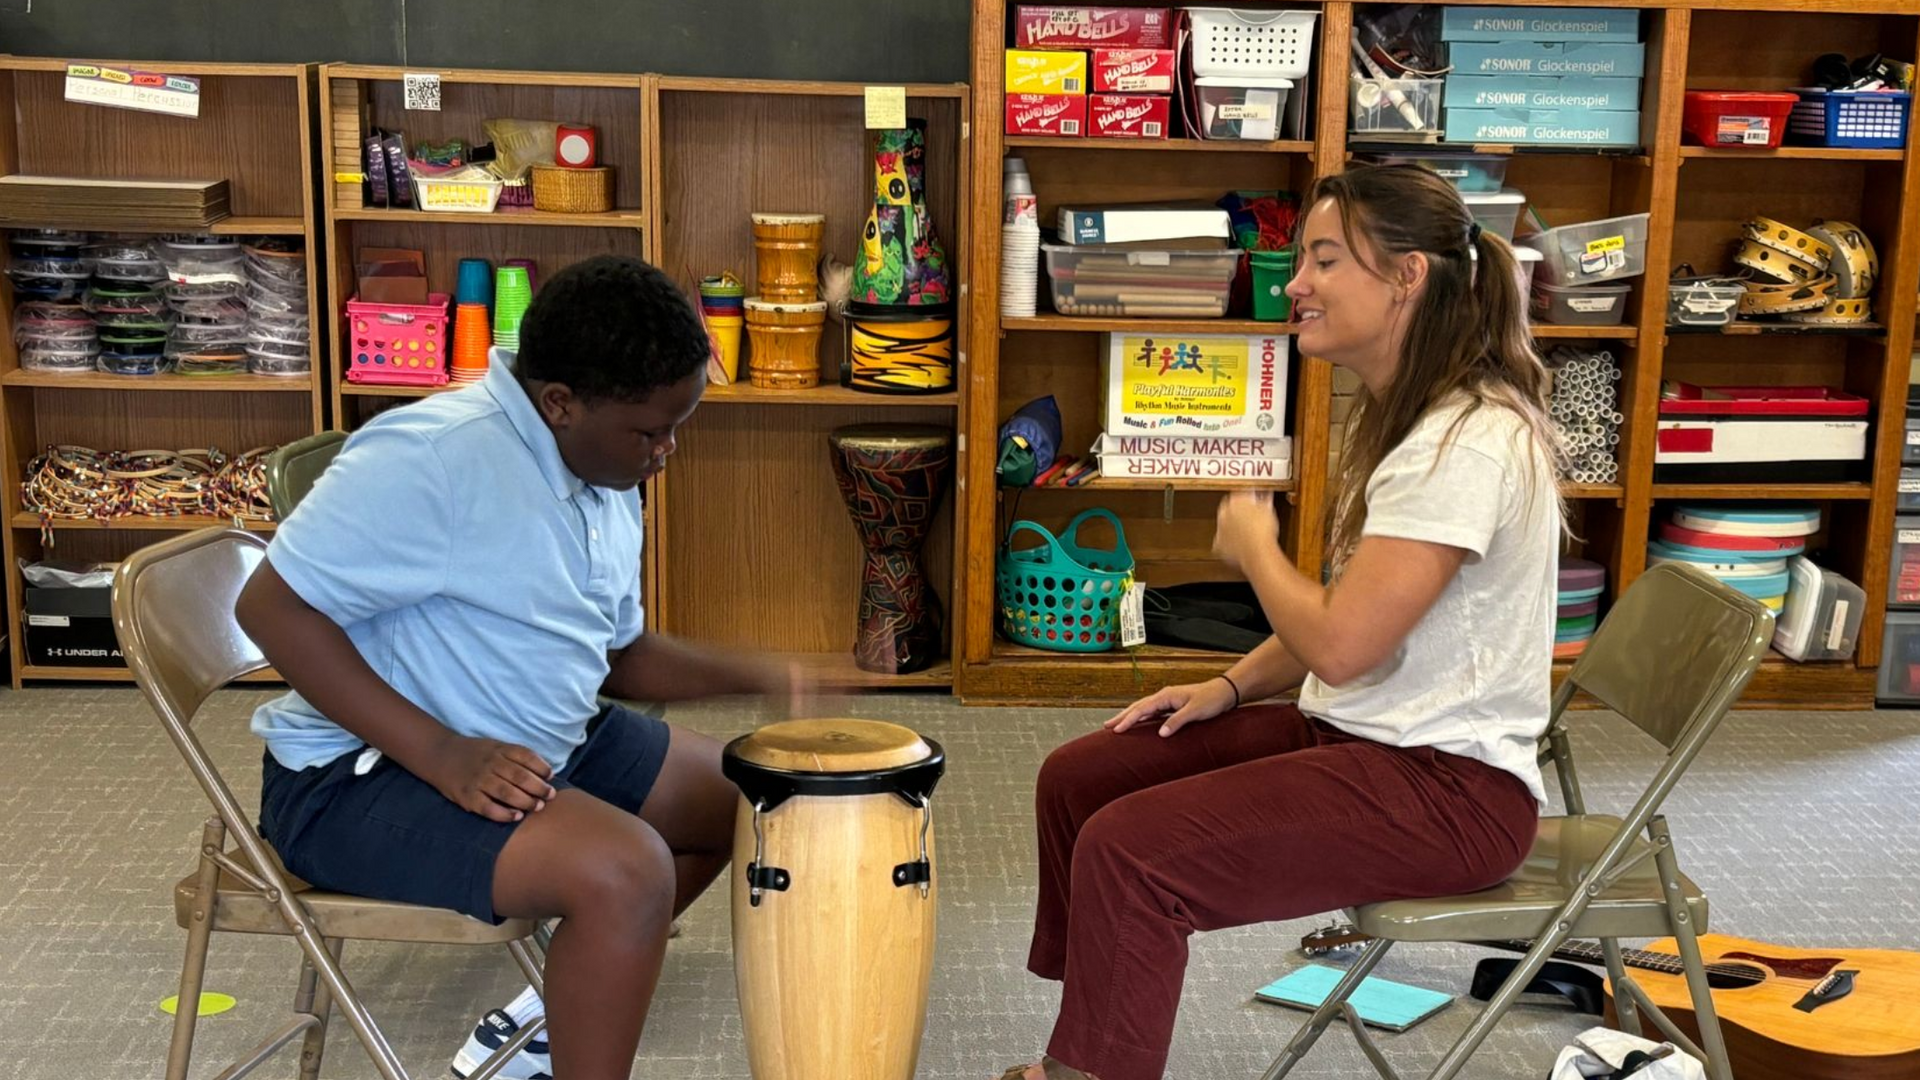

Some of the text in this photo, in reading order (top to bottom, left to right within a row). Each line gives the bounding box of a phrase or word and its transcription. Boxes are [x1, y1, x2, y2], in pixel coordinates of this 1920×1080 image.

[1077, 12, 1130, 40] BELLS
[1484, 19, 1608, 35] SONOR Glockenspiel
[1103, 64, 1131, 86] HAND
[1131, 52, 1159, 74] BELLS
[1491, 58, 1614, 74] SONOR Glockenspiel
[1486, 92, 1609, 108] SONOR Glockenspiel
[1015, 106, 1043, 128] HAND
[1043, 95, 1071, 117] BELLS
[1097, 97, 1153, 131] HAND BELLS
[1486, 126, 1609, 142] SONOR Glockenspiel
[1259, 339, 1275, 411] HOHNER
[1133, 384, 1236, 398] Playful Harmonies
[1135, 401, 1232, 412] Rhythm Music Instruments
[1123, 416, 1148, 429] Music
[1150, 420, 1157, 428] &
[1158, 417, 1174, 427] Fun
[1175, 415, 1202, 429] Rolled
[1120, 438, 1265, 456] MUSIC MAKER
[1128, 458, 1273, 477] MUSIC MAKER
[64, 649, 108, 657] UNDER
[487, 1013, 511, 1031] NIKE
